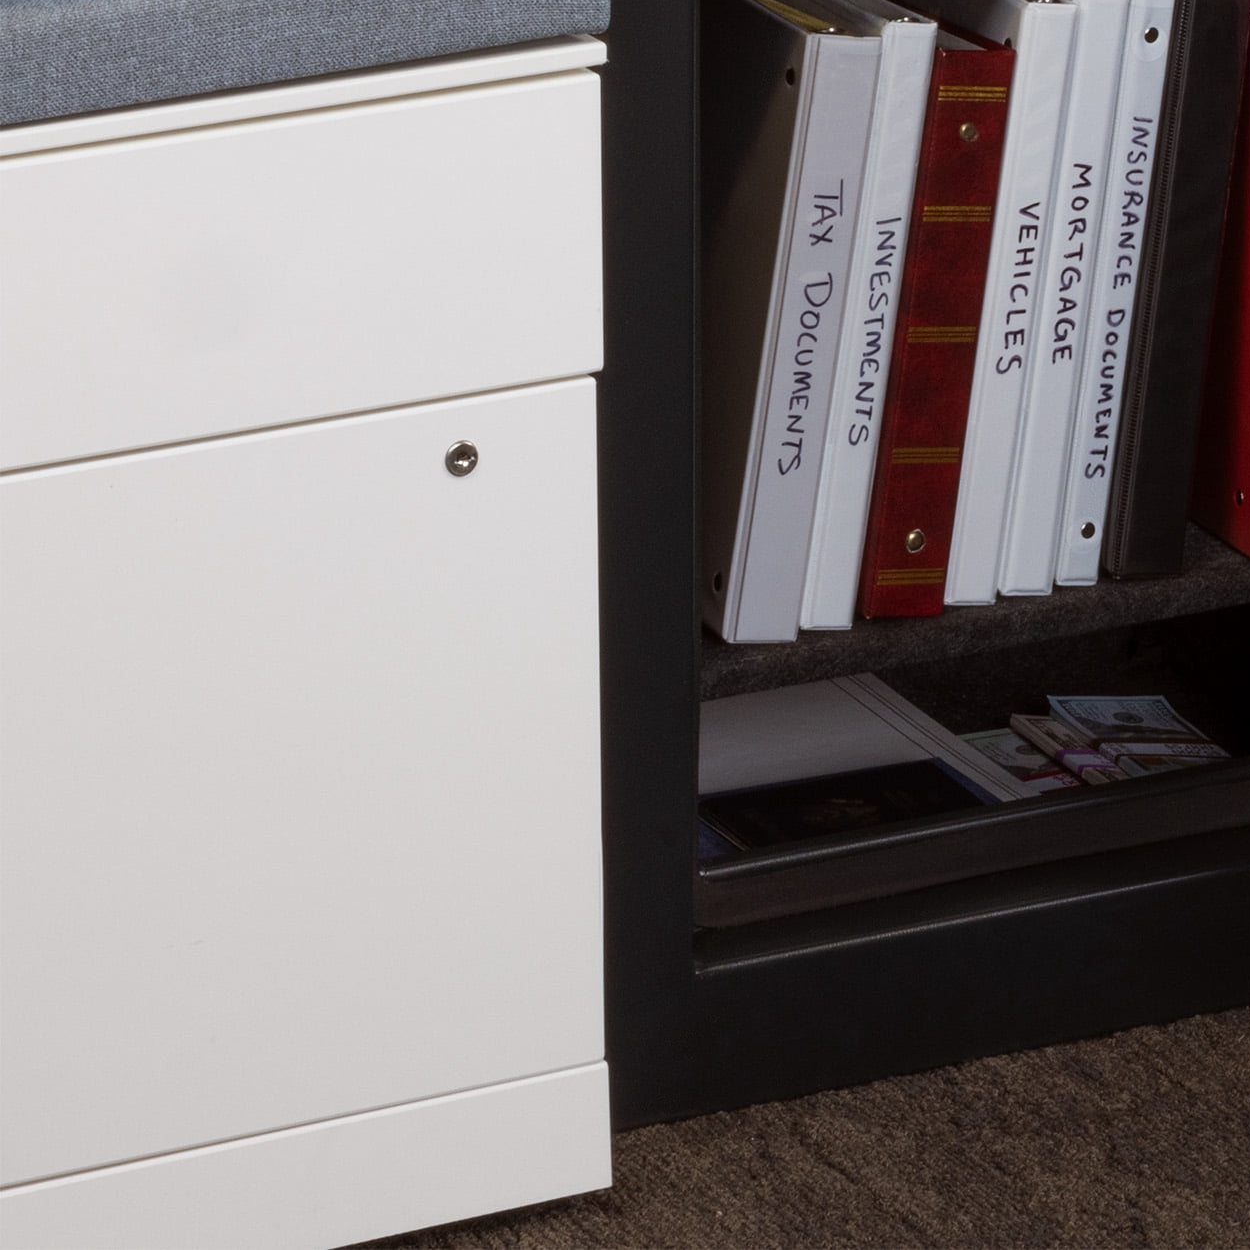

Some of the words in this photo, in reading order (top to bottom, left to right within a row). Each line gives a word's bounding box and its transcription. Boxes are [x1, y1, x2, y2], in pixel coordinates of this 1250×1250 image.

[809, 178, 844, 247] TAX
[995, 201, 1041, 376] VEHICLES
[1051, 162, 1093, 364] MORTGAGE
[1112, 115, 1153, 290] INSURANCE
[777, 271, 833, 476] DOCUMENTS
[848, 216, 902, 447] INVESTMENTS
[1083, 308, 1127, 481] DOCUMENTS
